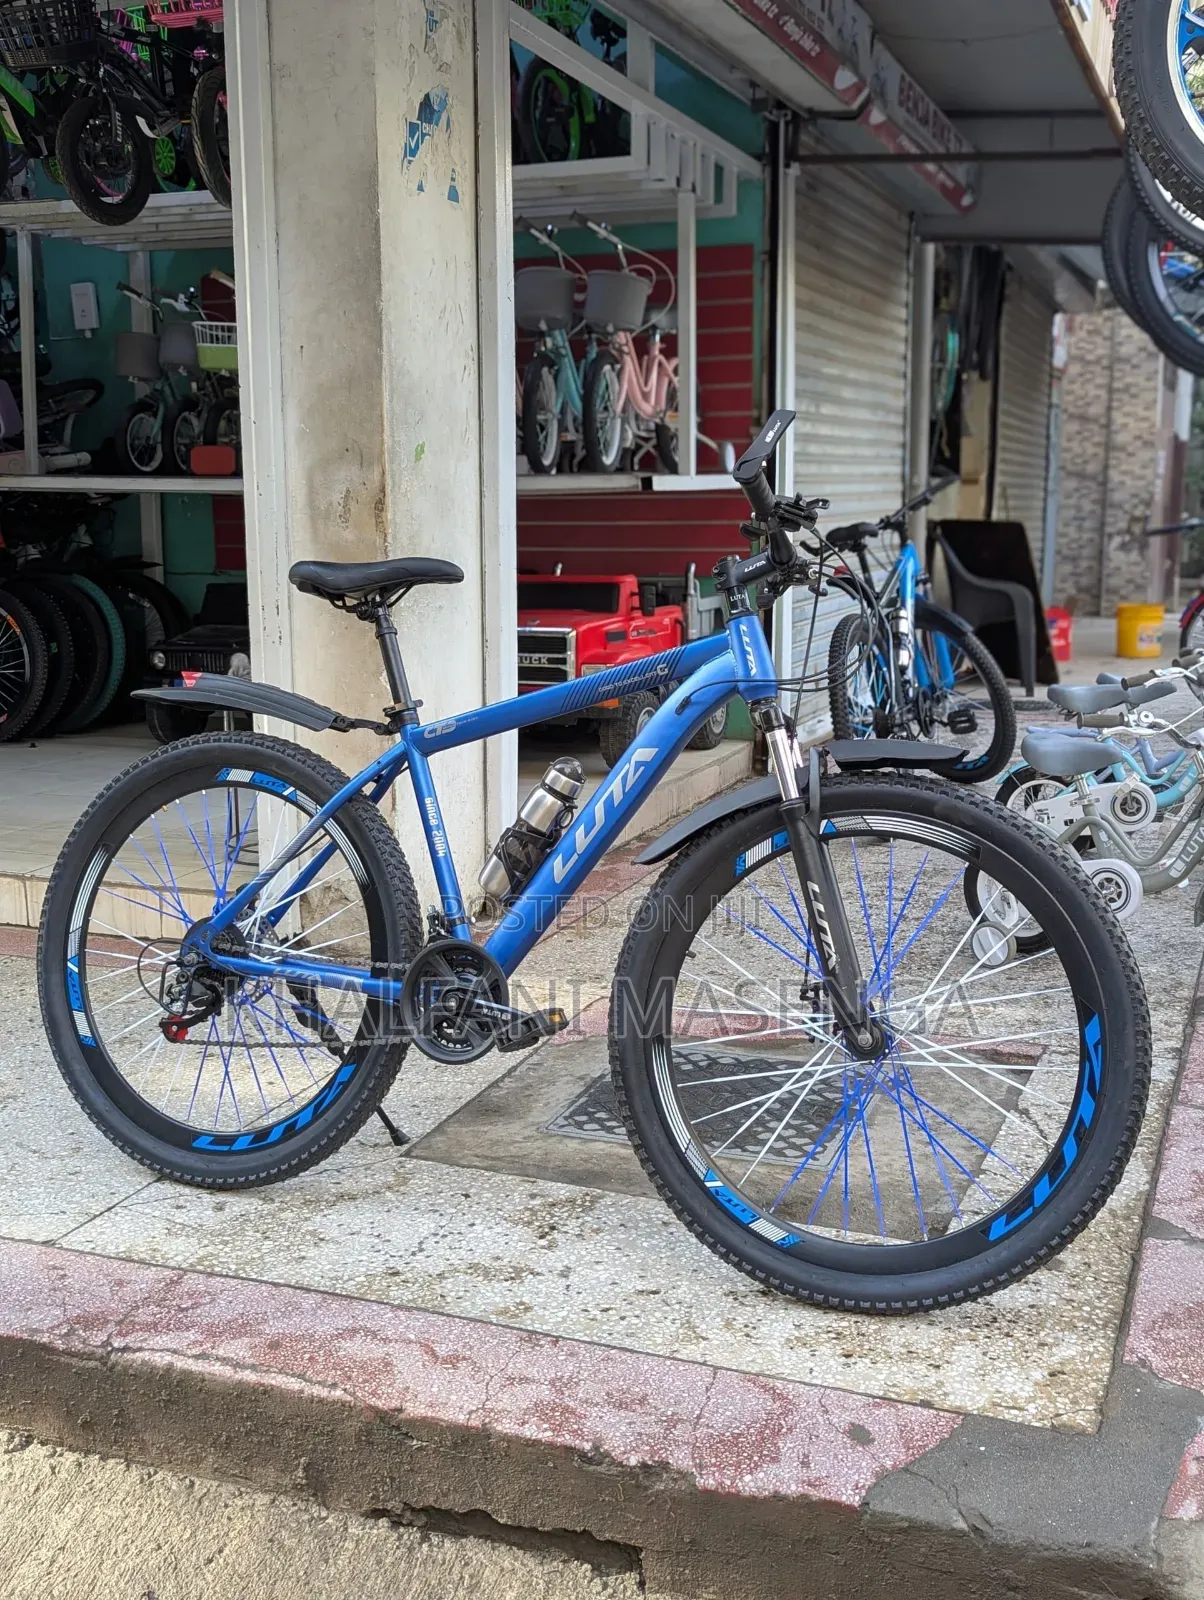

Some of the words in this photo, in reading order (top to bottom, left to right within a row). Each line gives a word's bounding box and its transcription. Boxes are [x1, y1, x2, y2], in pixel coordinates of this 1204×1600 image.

[744, 560, 767, 573] LUTA
[730, 593, 746, 602] LUTA
[739, 623, 757, 677] LUTA
[554, 747, 660, 884] LUTA
[432, 830, 447, 858] 2004
[805, 880, 838, 970] LUTA
[273, 967, 322, 982] LUTA
[191, 1063, 357, 1152] LUTA
[988, 1012, 1103, 1243] LUTA
